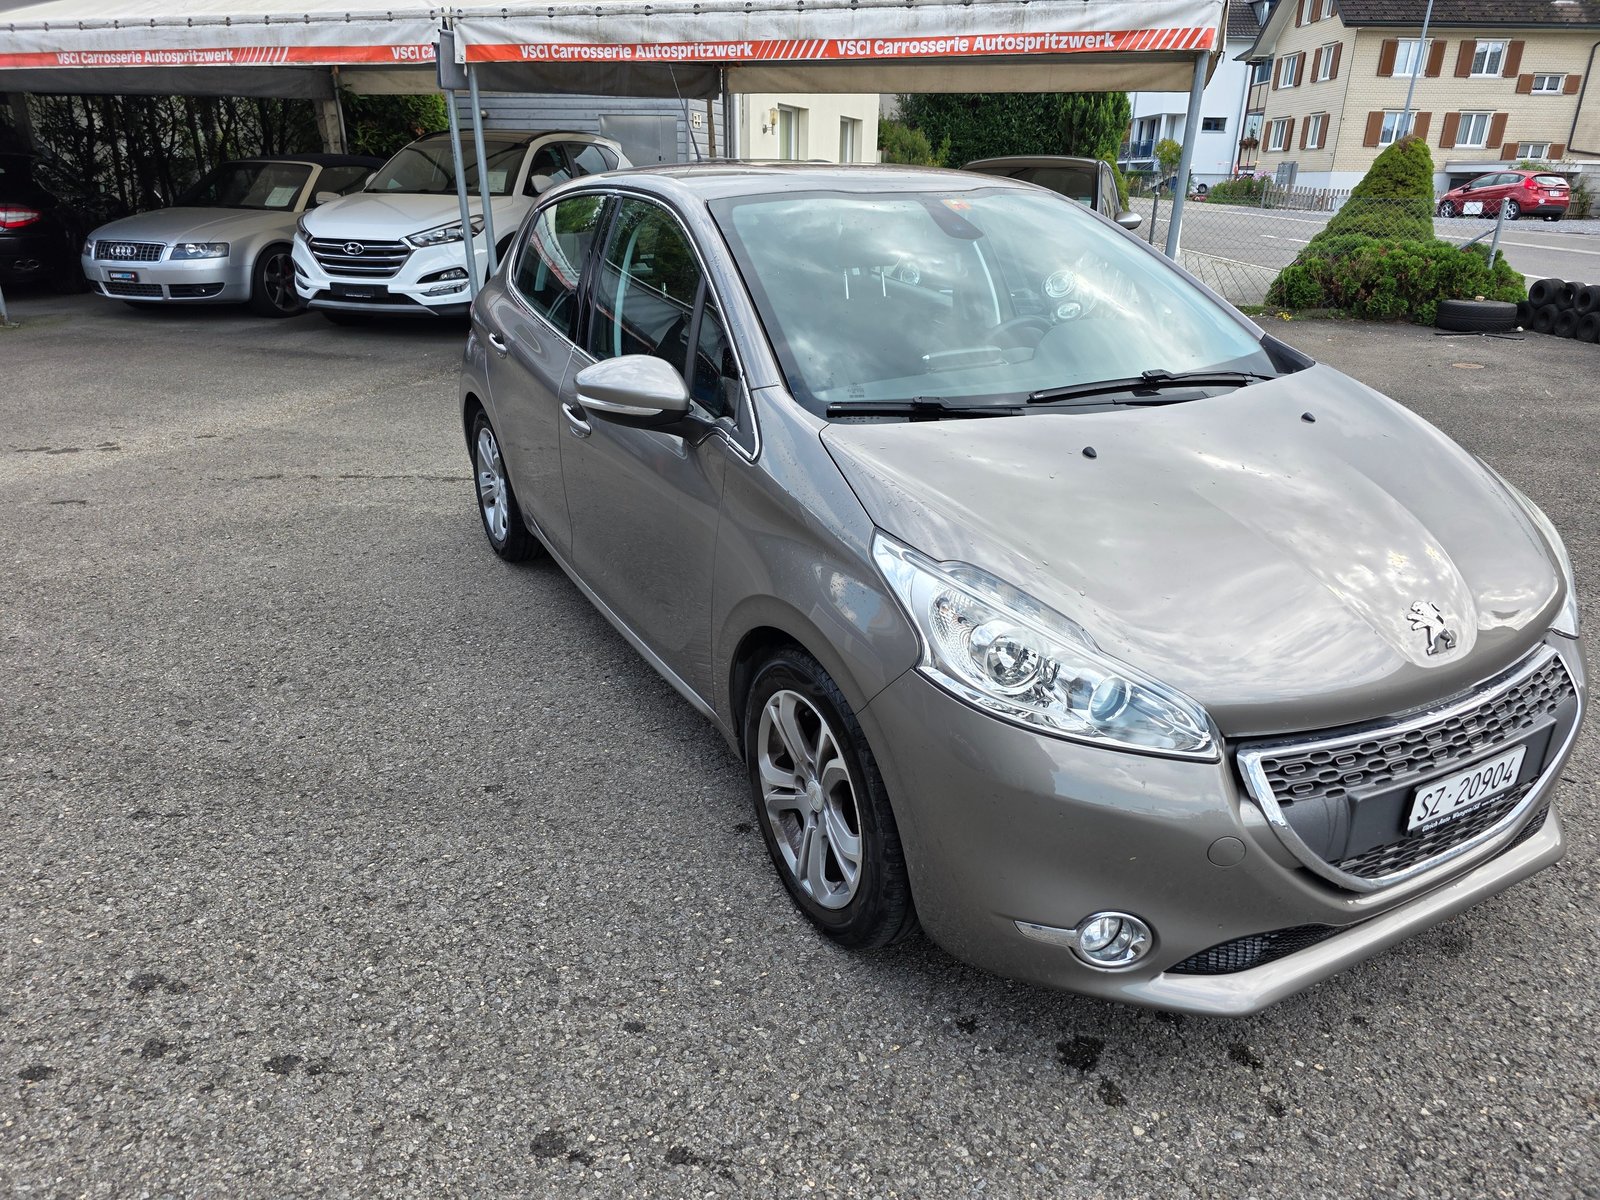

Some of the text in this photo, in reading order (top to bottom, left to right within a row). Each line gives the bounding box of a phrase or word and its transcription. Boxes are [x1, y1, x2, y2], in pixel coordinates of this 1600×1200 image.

[520, 42, 753, 60] VSCI Carrosserie Autospritzwerk
[836, 32, 1116, 56] VSCI Carrosserie Autospritzwerk
[56, 49, 234, 65] VSCI Carrosserie Autospritzwerk
[391, 46, 420, 60] VSCI
